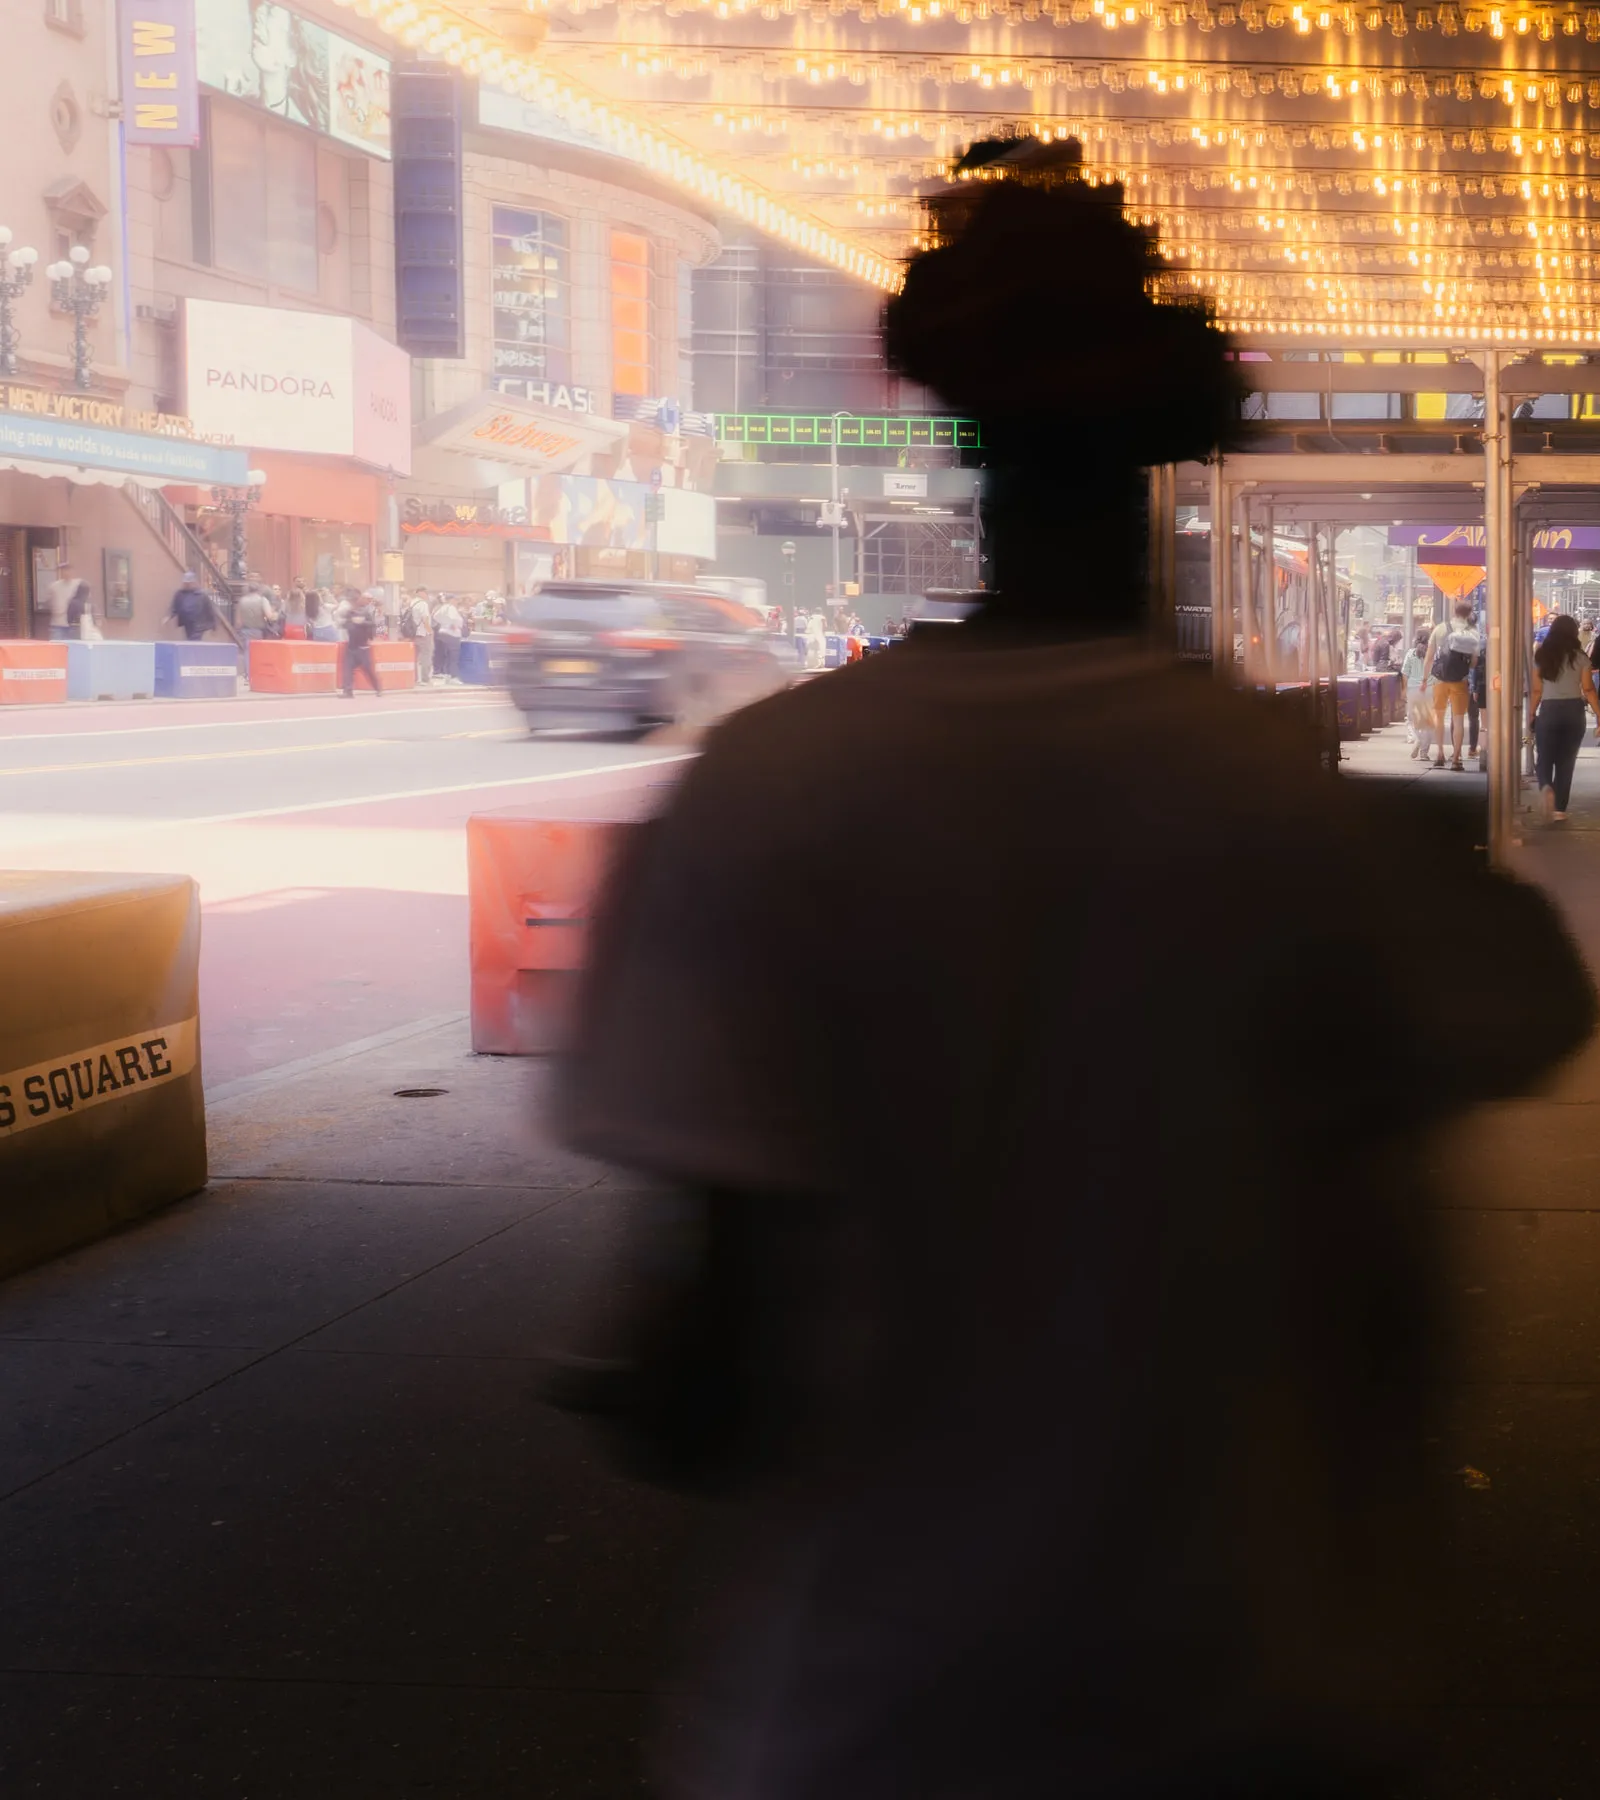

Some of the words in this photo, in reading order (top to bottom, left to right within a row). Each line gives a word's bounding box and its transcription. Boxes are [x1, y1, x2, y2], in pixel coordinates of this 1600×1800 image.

[132, 20, 178, 130] NEW
[205, 367, 337, 400] PANDORA
[8, 386, 50, 414] NEW
[52, 393, 125, 428] VICTORY
[27, 431, 54, 449] new
[56, 434, 99, 456] worlds
[473, 414, 584, 459] Subway
[24, 1036, 172, 1118] SQUARE
